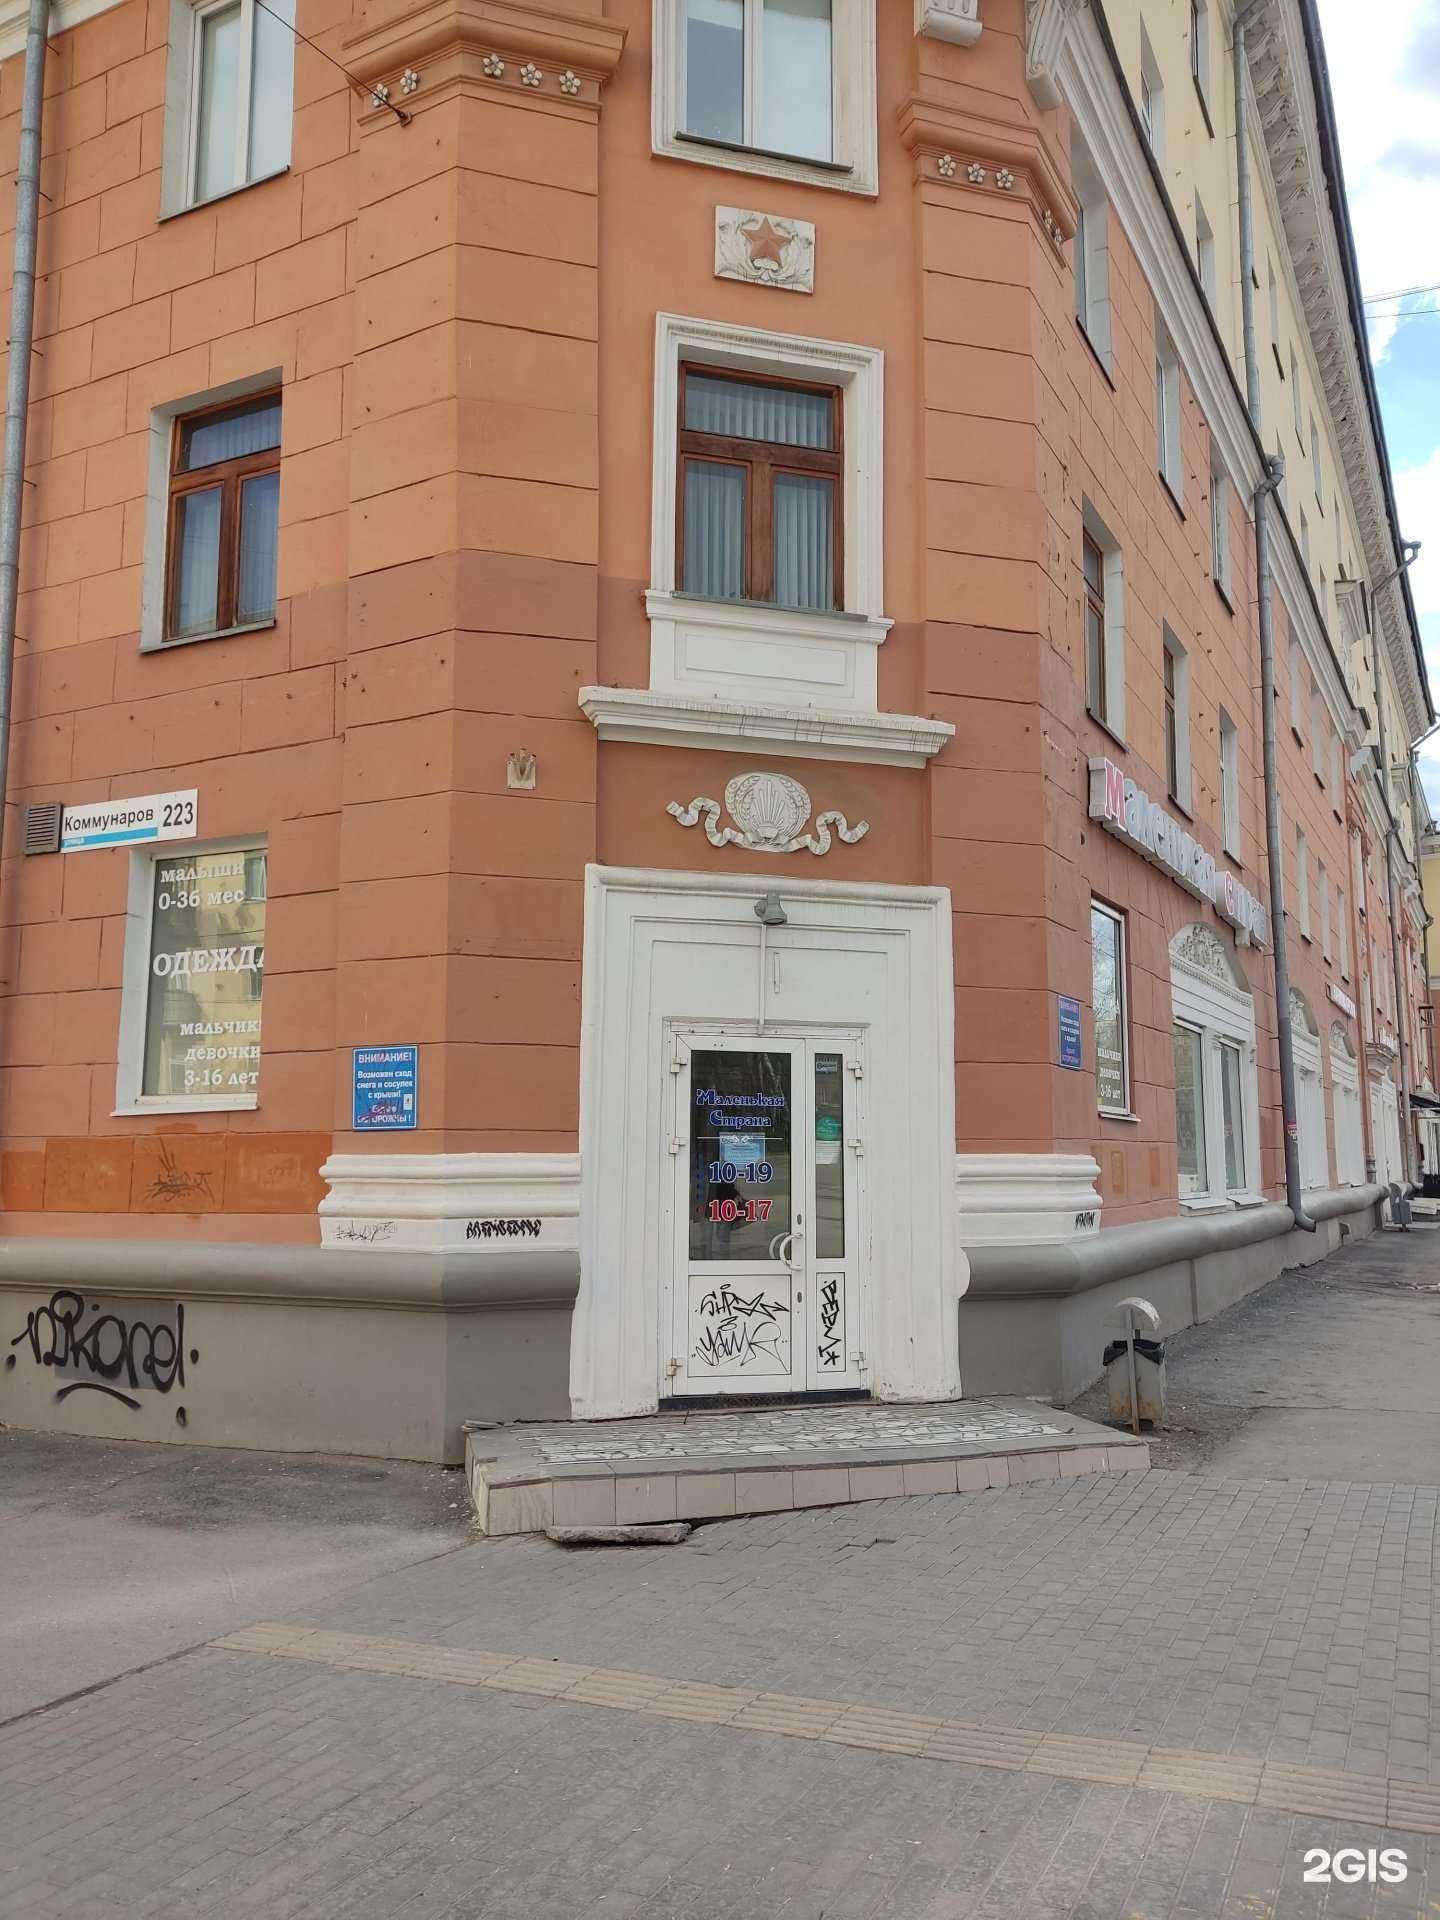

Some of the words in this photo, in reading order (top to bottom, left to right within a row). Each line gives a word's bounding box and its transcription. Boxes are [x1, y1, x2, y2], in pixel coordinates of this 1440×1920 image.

[64, 808, 154, 832] Коммунаров
[162, 801, 195, 828] 223
[160, 862, 245, 883] малыши
[158, 889, 201, 911] 0-36
[207, 889, 245, 906] мес
[179, 1020, 260, 1036] мальчик
[184, 1068, 224, 1087] 3-16
[227, 1071, 260, 1086] лет
[696, 1088, 785, 1107] Маленькая
[709, 1109, 773, 1130] Страна
[709, 1161, 774, 1184] 10-19
[708, 1199, 774, 1222] 10-17
